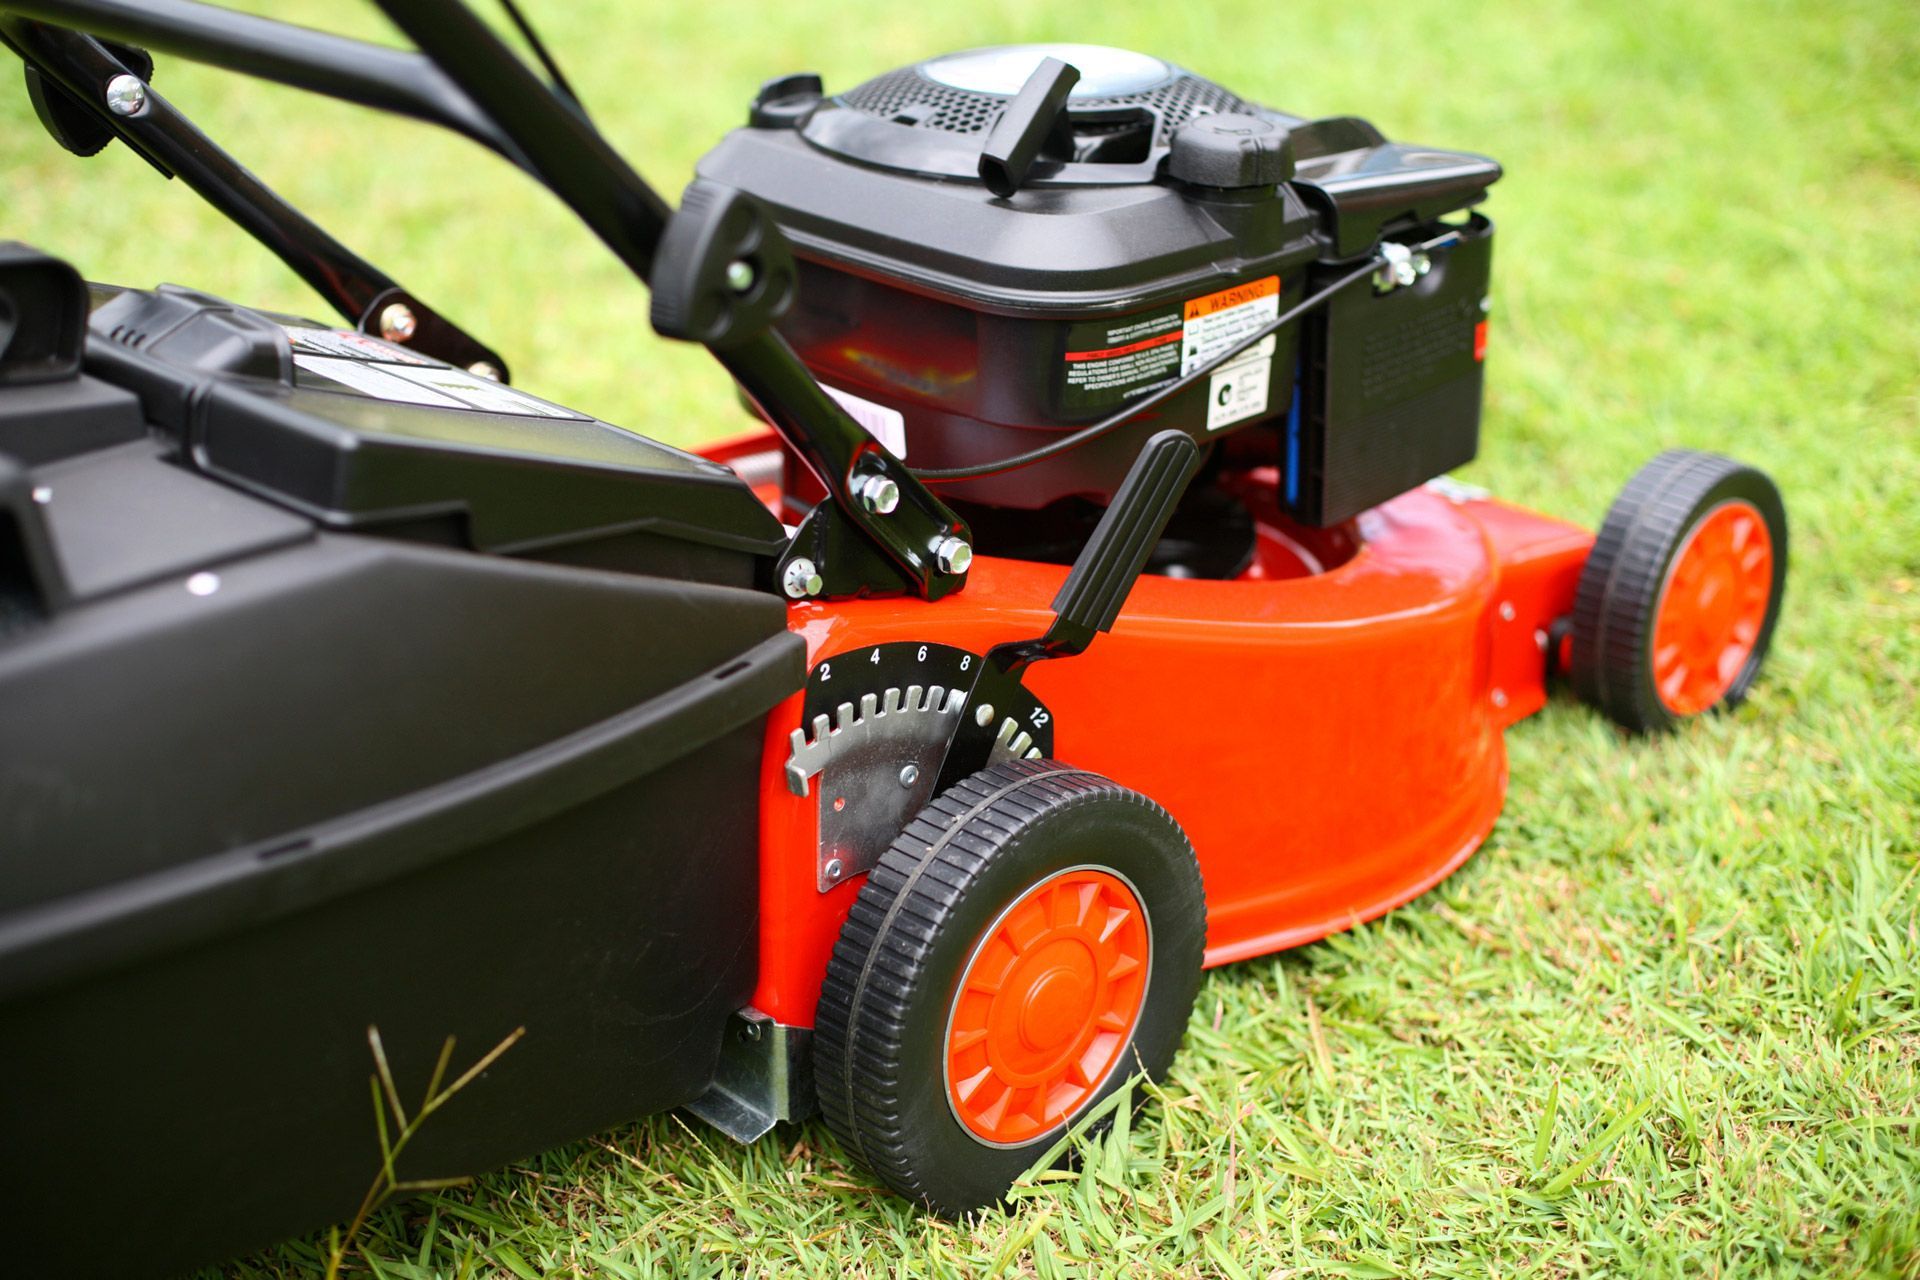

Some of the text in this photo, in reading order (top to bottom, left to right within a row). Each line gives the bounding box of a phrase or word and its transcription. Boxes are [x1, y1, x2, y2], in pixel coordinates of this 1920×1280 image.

[1210, 283, 1262, 310] WARNING
[820, 646, 1050, 728] 2 4 6 8 12
